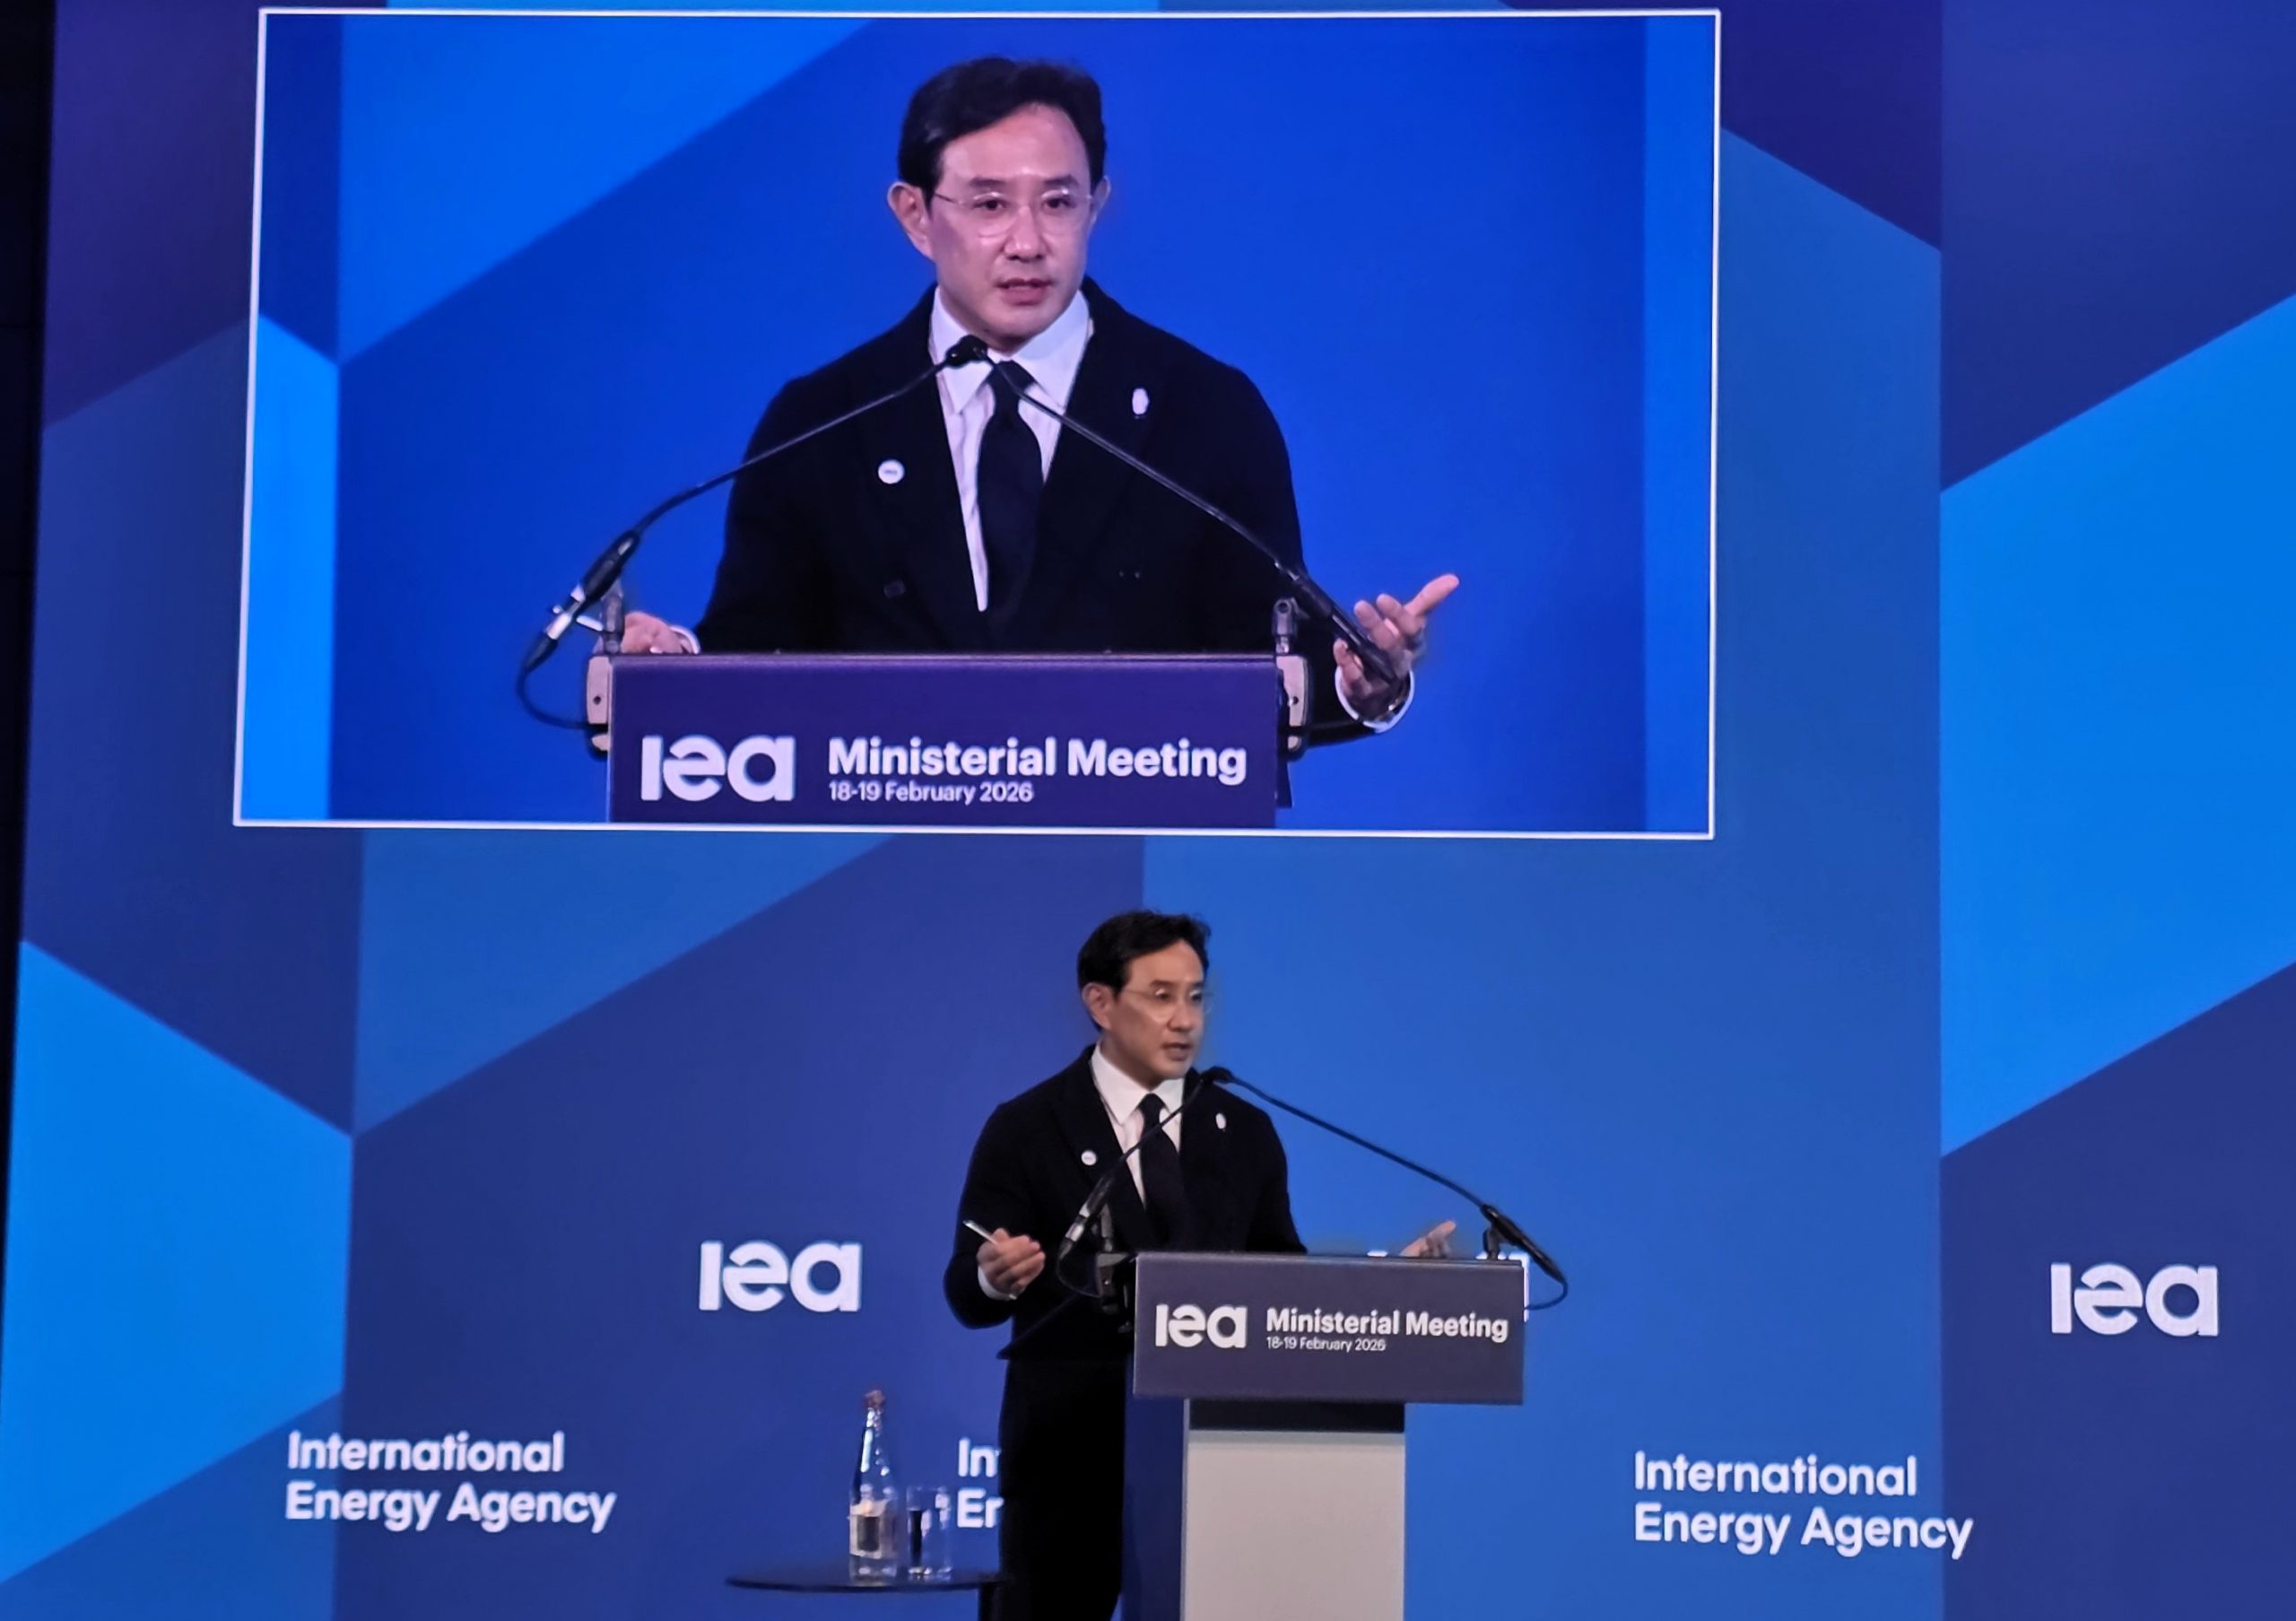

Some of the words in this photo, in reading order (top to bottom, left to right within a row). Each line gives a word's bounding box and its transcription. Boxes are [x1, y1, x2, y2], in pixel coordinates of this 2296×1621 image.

[828, 736, 1057, 777] Ministerial
[1067, 737, 1247, 786] Meeting
[829, 780, 880, 801] 18-19
[884, 780, 975, 806] February
[979, 781, 1034, 802] 2026
[1266, 1307, 1401, 1335] Ministerial
[1405, 1311, 1509, 1343] Meeting
[1266, 1336, 1297, 1350] 18-19
[1300, 1337, 1352, 1353] February
[1354, 1338, 1387, 1351] 2026
[287, 1430, 564, 1473] International
[1634, 1450, 1918, 1497] International
[285, 1481, 439, 1533] Energy
[445, 1482, 617, 1534] Agency
[1634, 1502, 1791, 1556] Energy
[1800, 1507, 1975, 1560] Agency
